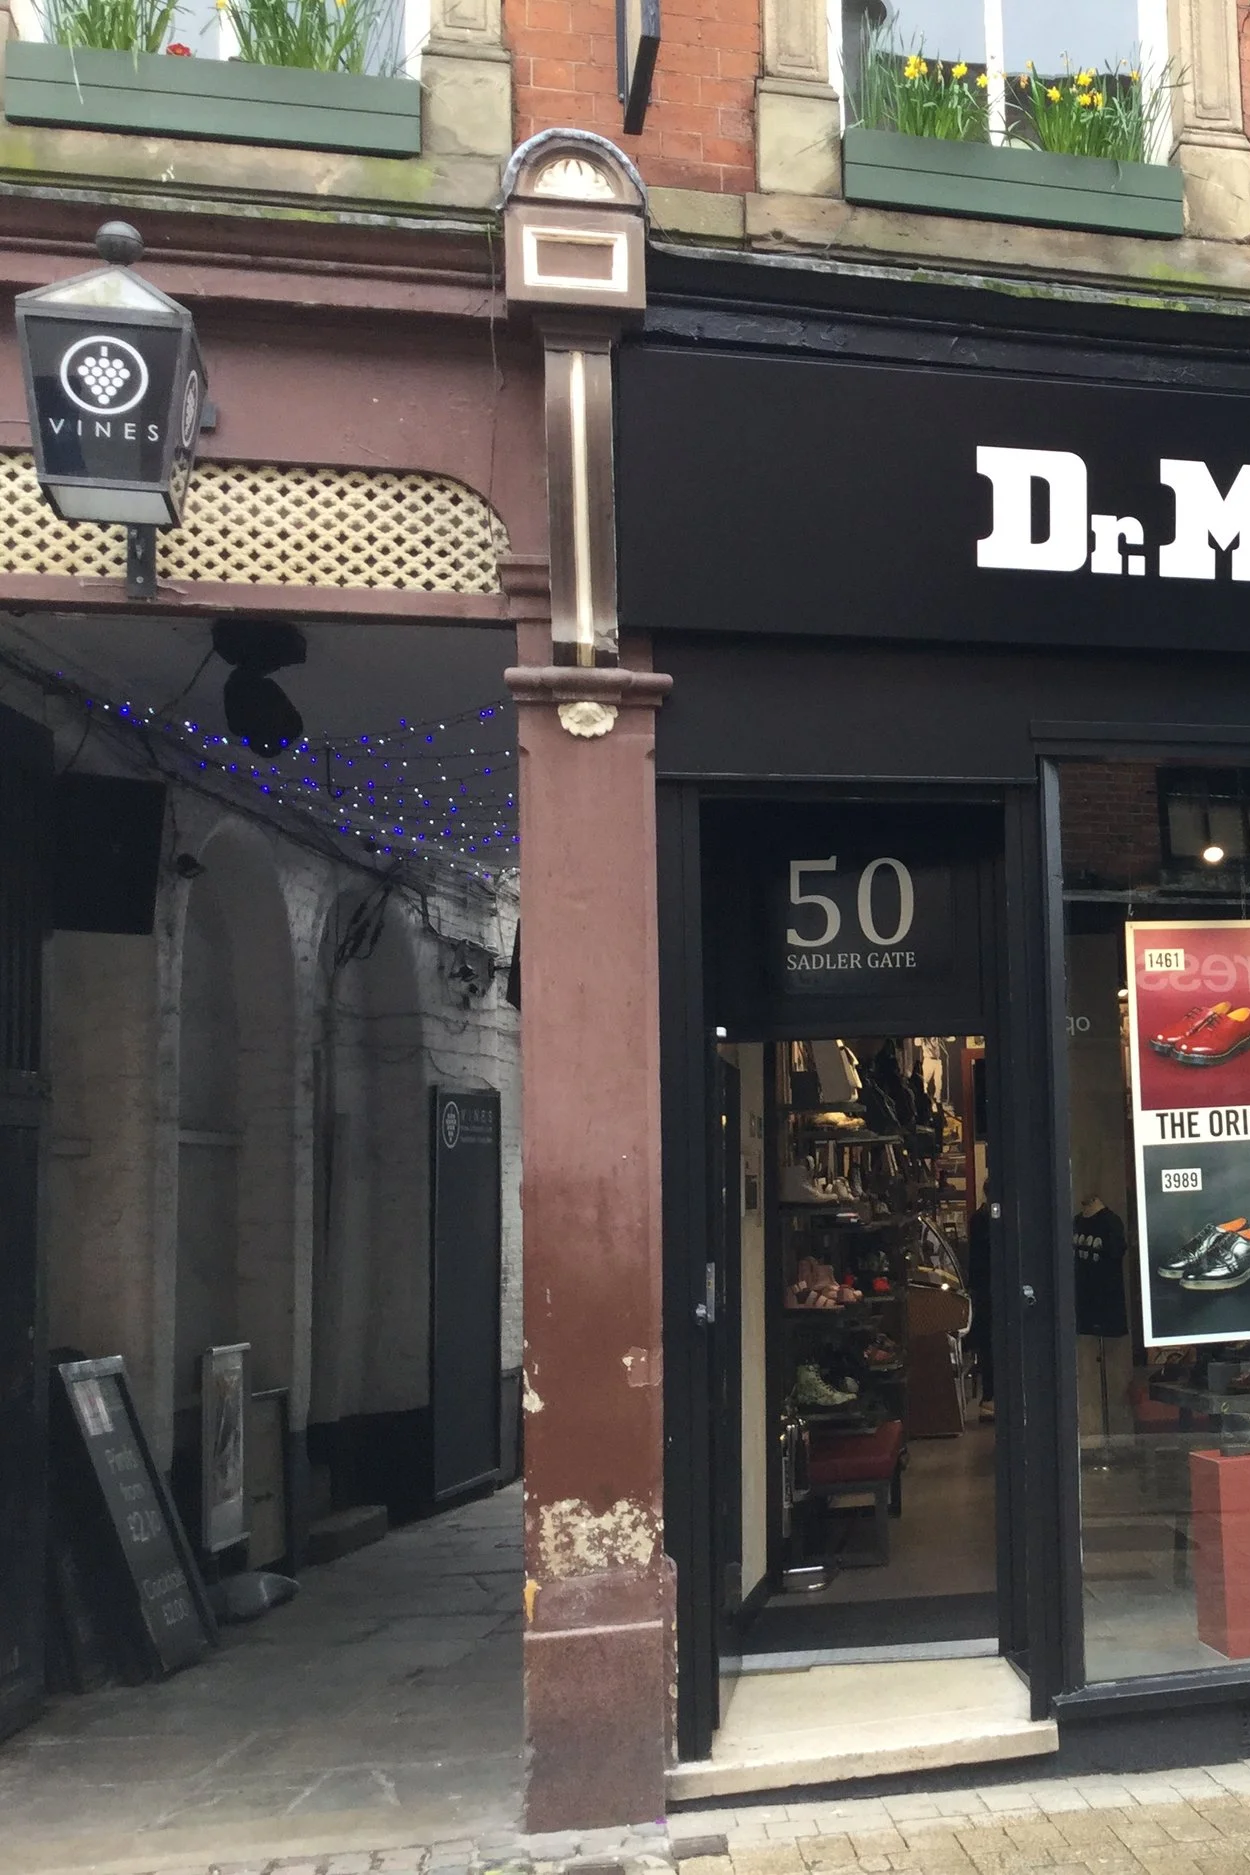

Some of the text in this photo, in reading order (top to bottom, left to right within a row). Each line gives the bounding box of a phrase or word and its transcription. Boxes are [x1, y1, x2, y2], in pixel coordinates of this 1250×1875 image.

[49, 417, 160, 442] VINES
[977, 445, 1146, 577] Dr.
[786, 855, 914, 947] 50
[787, 952, 917, 970] SADLER GATE
[1147, 952, 1181, 968] 1461
[1156, 1110, 1199, 1140] THE
[1164, 1171, 1199, 1188] 3989
